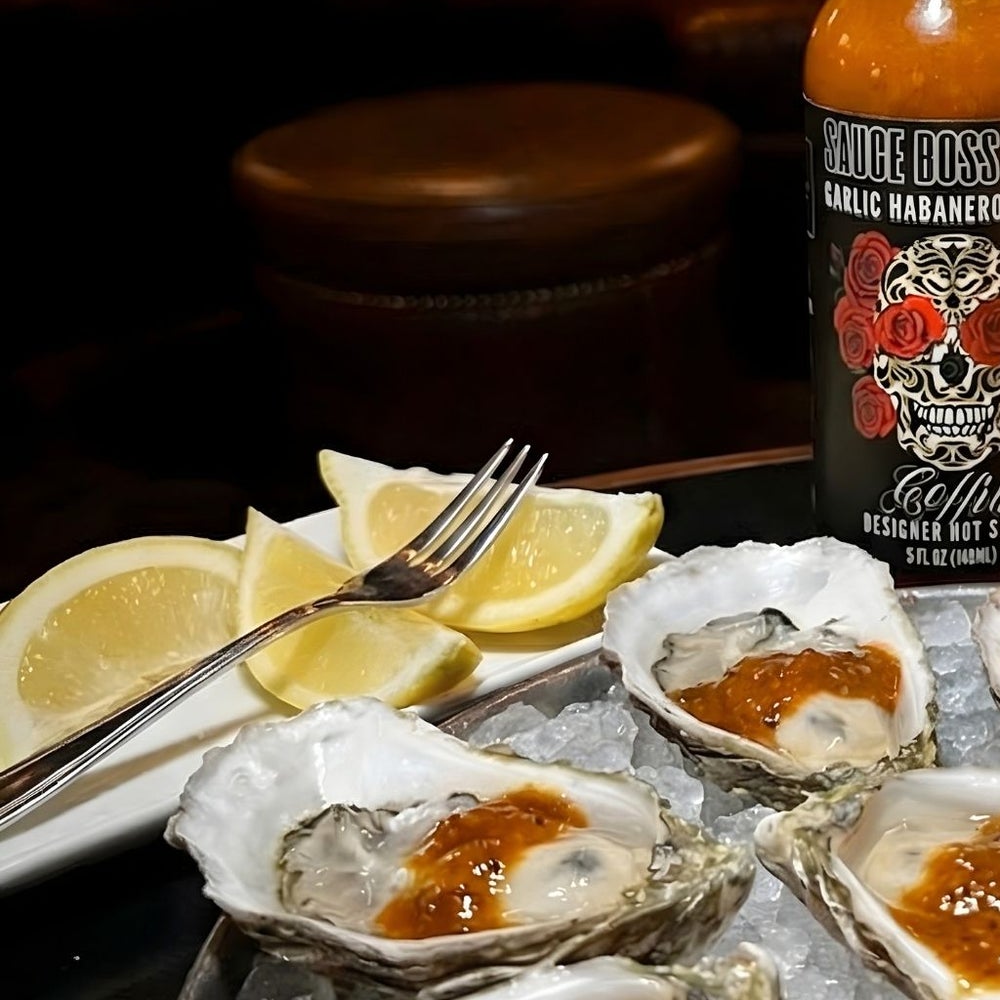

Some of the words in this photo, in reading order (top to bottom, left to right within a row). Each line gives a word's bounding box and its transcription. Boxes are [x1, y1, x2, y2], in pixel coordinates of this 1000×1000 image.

[823, 117, 905, 184] SAUCE
[914, 129, 1000, 187] BOSS
[824, 180, 881, 219] GARLIC
[863, 511, 942, 542] DESIGNER
[950, 519, 983, 542] HOT
[932, 548, 948, 566] OZ
